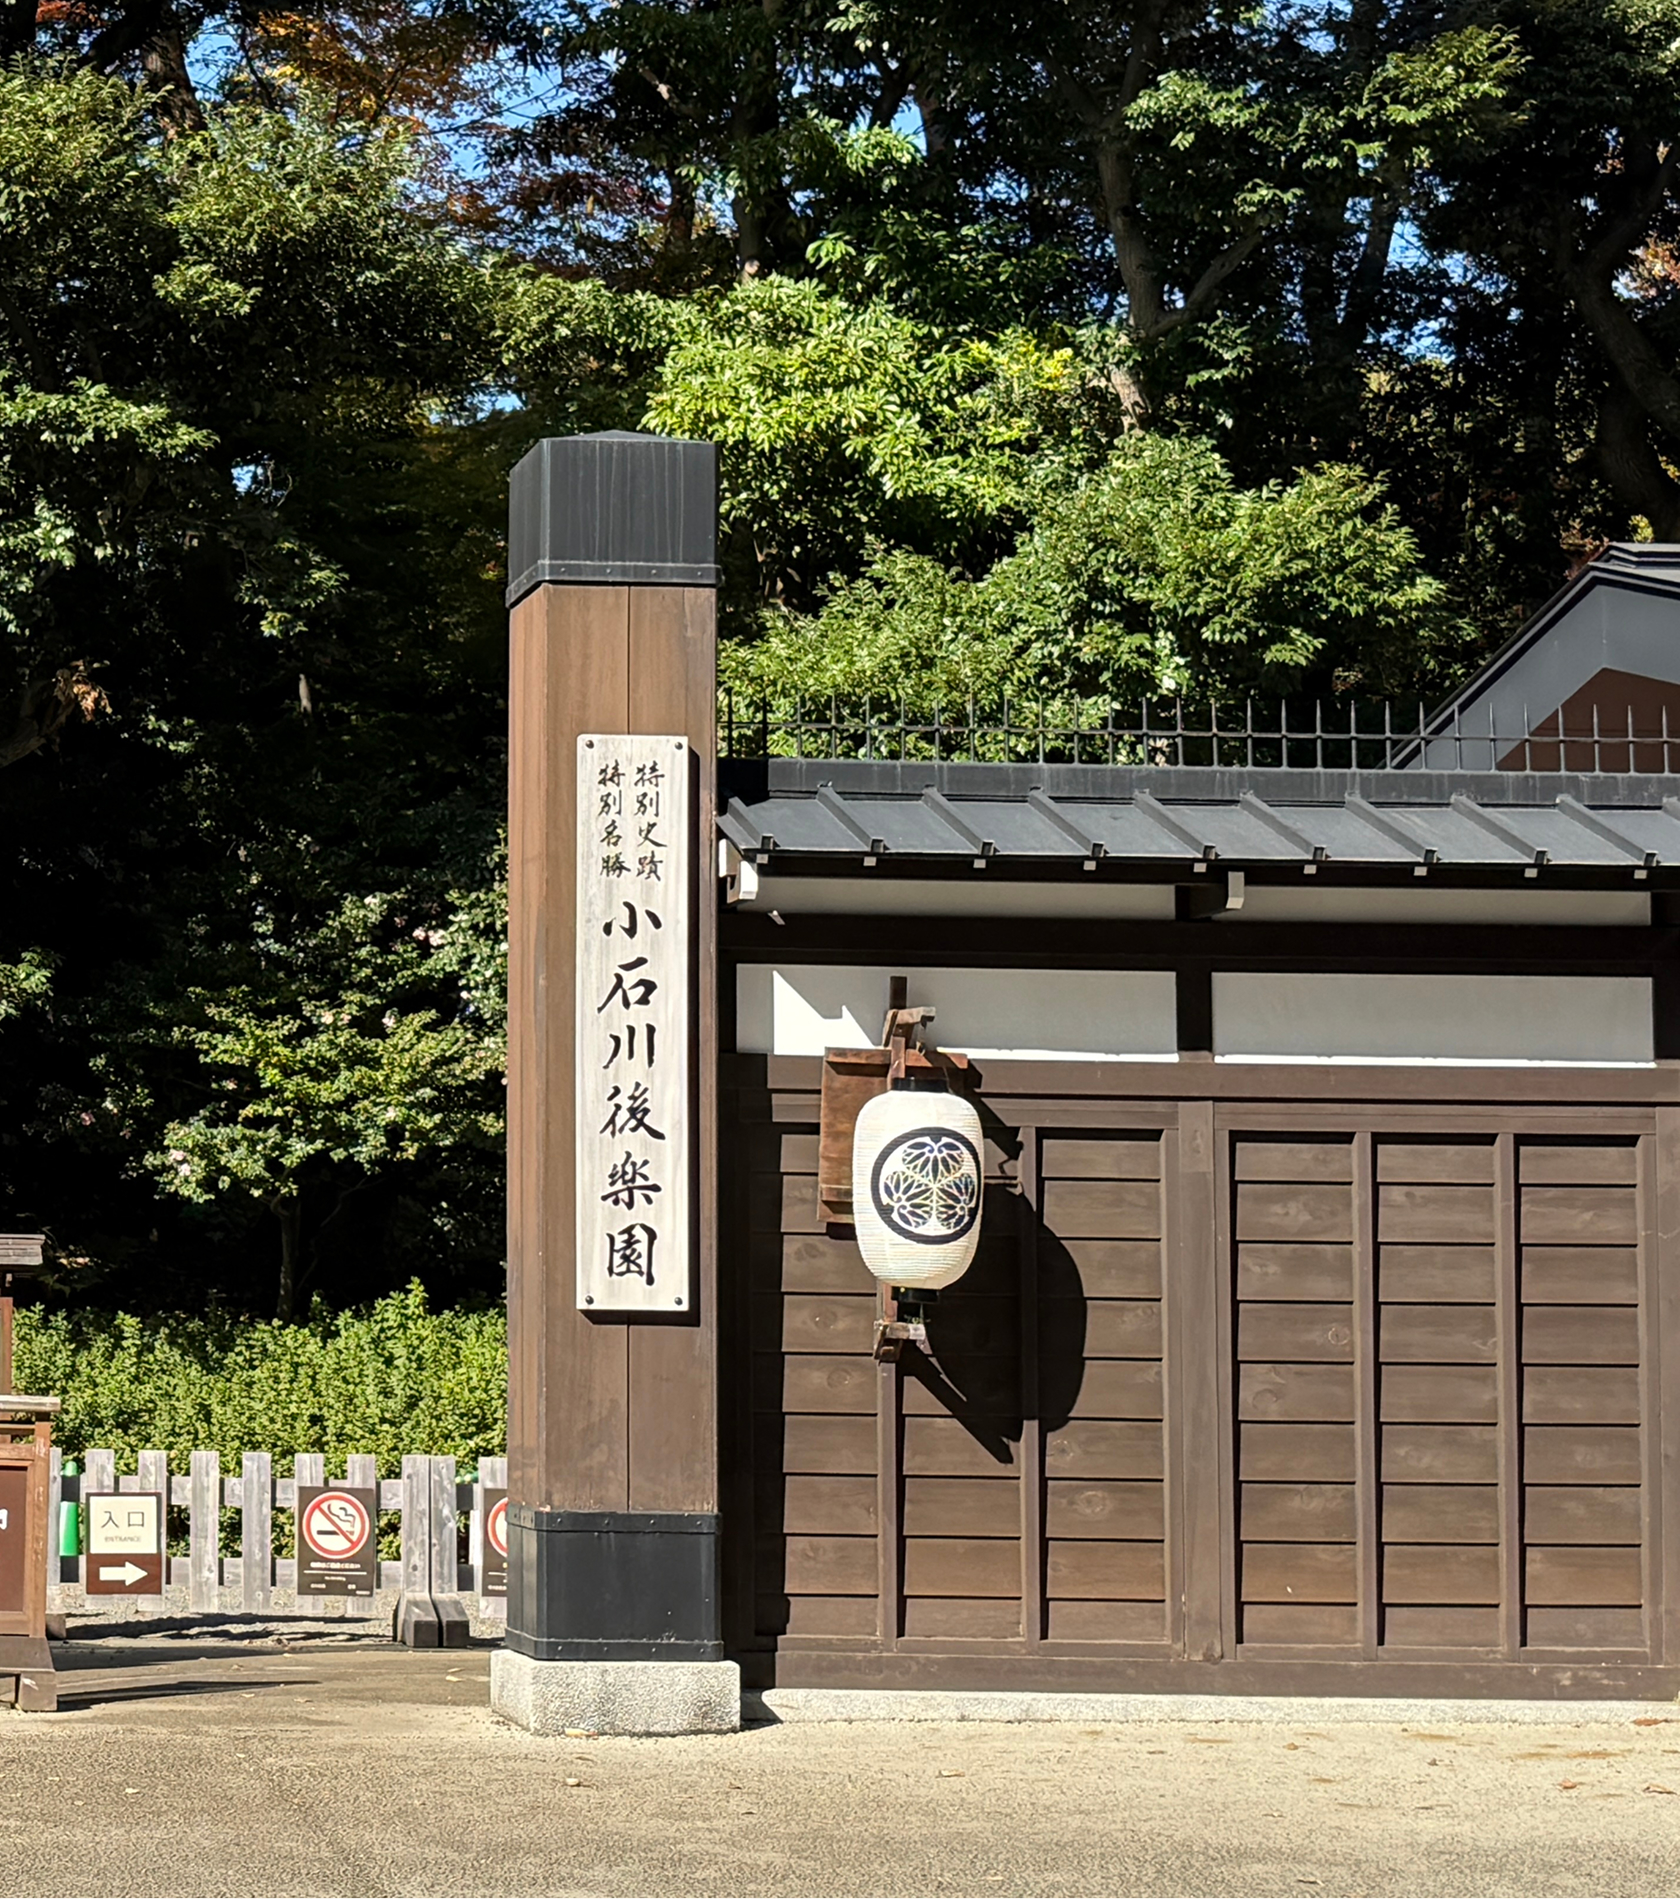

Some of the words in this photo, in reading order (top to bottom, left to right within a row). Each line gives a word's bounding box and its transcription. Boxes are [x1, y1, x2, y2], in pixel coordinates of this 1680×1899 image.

[597, 758, 631, 880] 特別名勝
[101, 1510, 145, 1528] 入口
